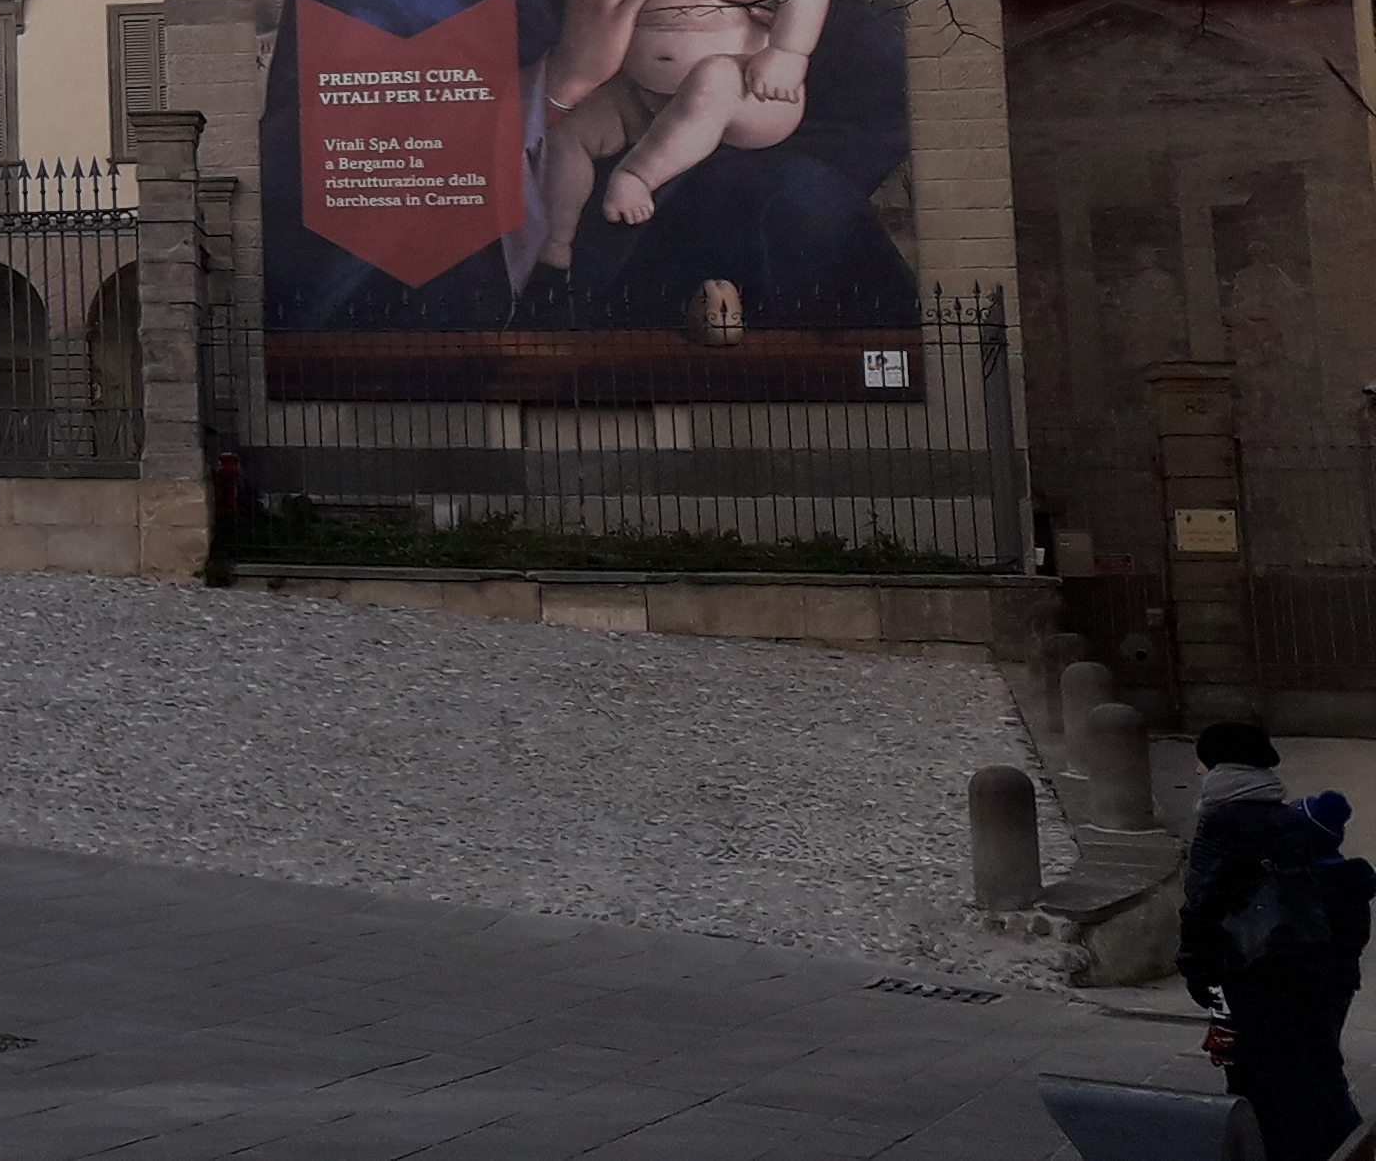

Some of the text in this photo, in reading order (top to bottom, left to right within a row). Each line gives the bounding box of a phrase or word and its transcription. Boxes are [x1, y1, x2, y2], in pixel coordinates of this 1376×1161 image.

[318, 68, 484, 87] PRENDERSI CURA.
[319, 87, 496, 105] VITALI PER L'ARTE.
[323, 137, 444, 154] Vitali SpA dona
[325, 155, 424, 173] a Bergamo la
[325, 173, 487, 189] ristrutturazione della
[325, 192, 485, 208] barchessa in Carrara
